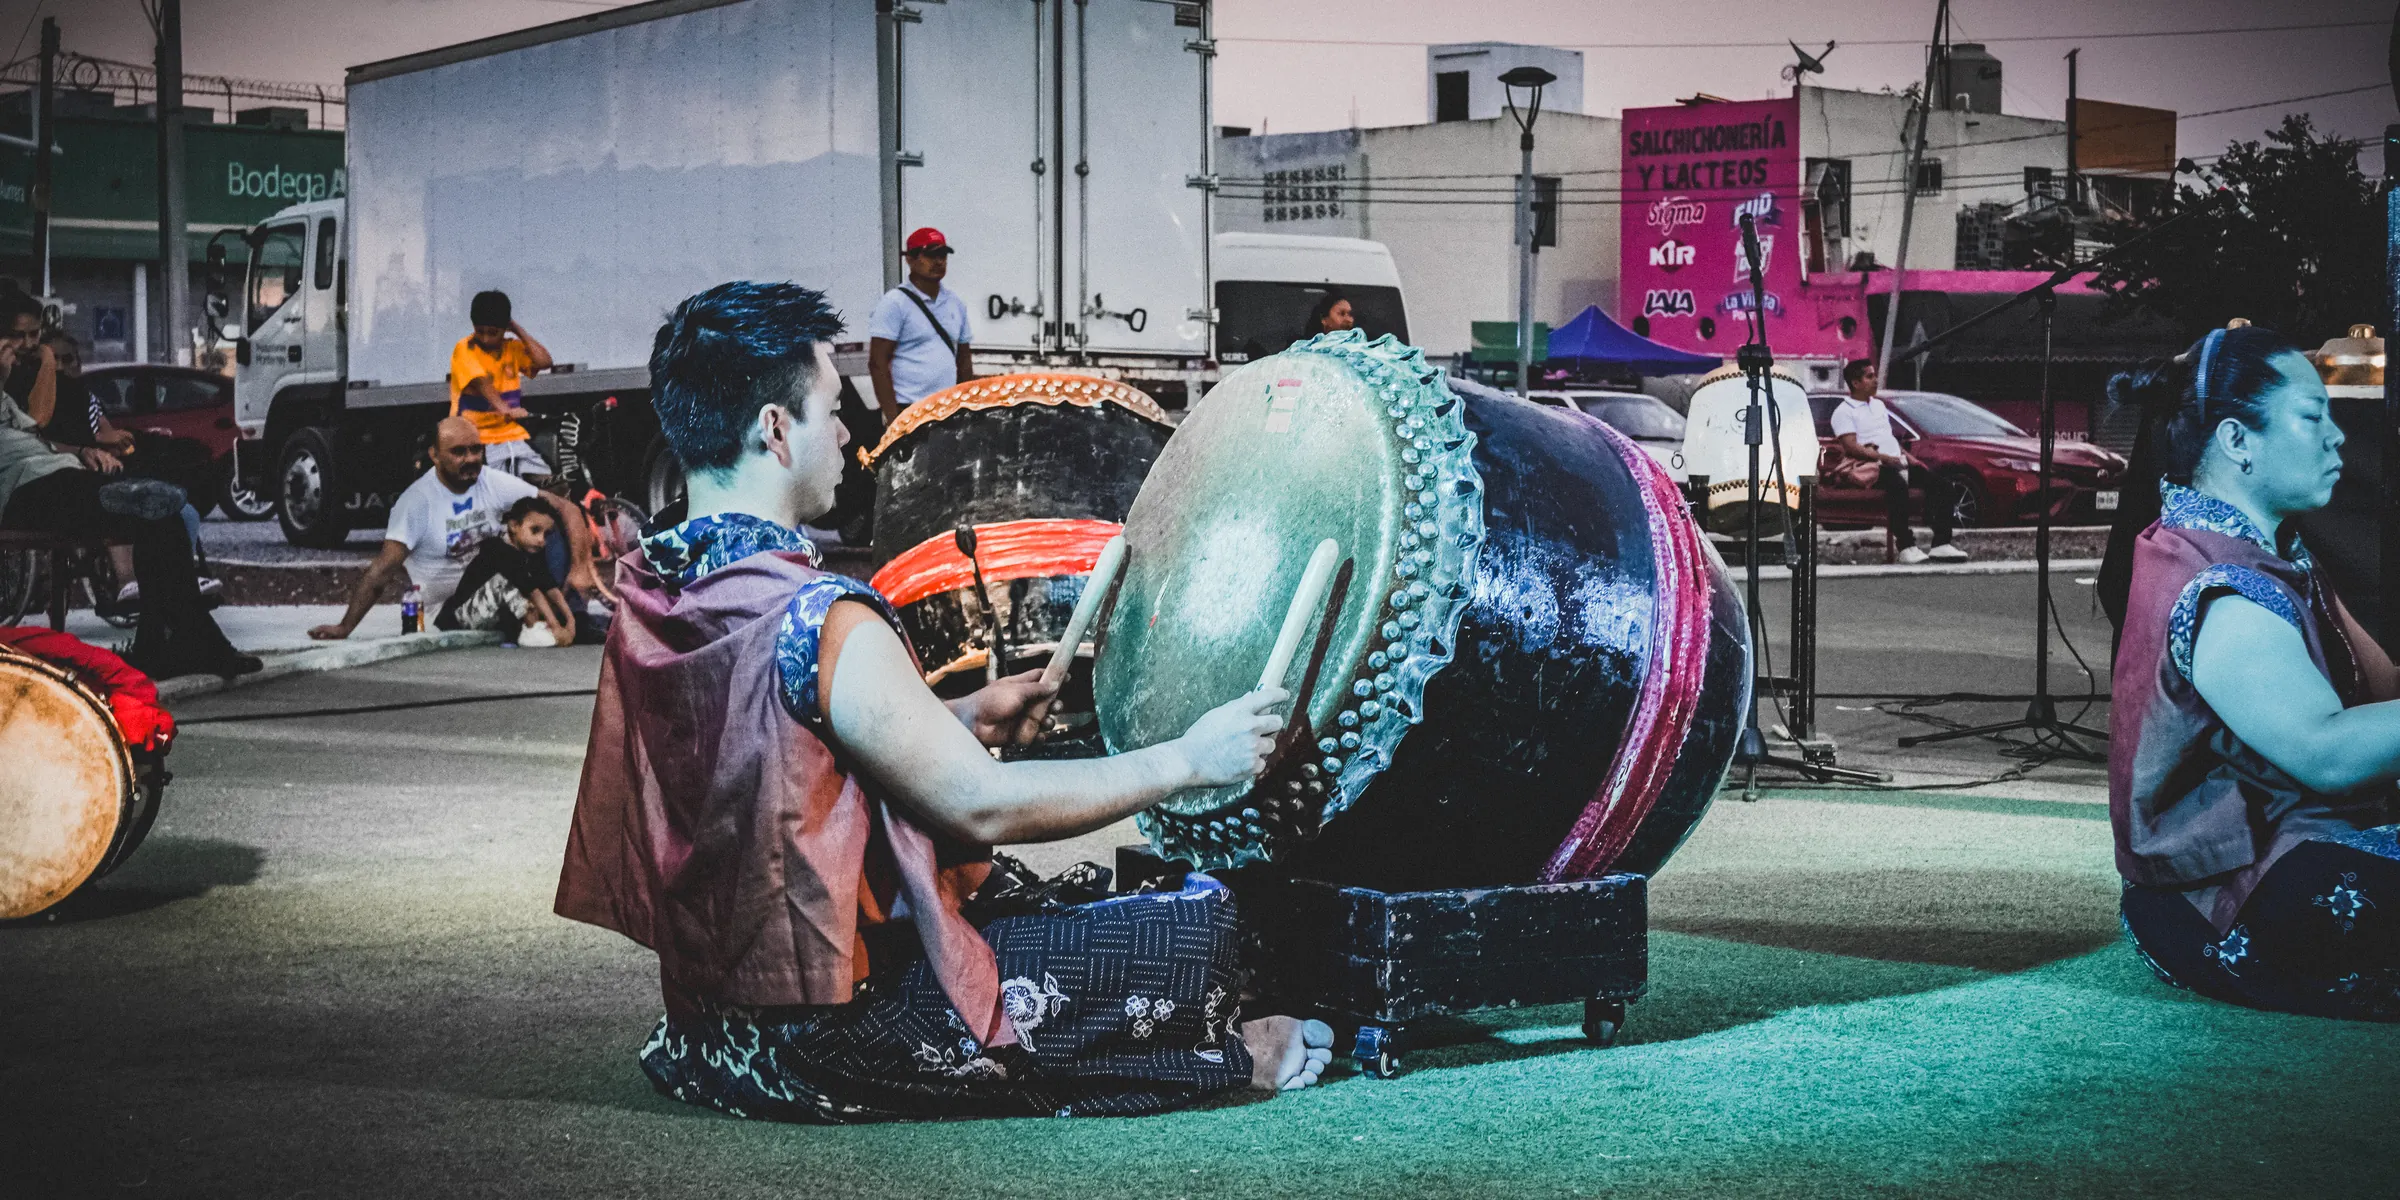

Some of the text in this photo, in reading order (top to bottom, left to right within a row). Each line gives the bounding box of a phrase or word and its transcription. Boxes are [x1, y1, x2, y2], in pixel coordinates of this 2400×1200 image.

[1629, 114, 1787, 156] SALCHICHONERÍA
[228, 162, 326, 204] Bodega
[1638, 158, 1768, 191] Y LACTEOS
[1647, 198, 1706, 236] Sigma
[1649, 240, 1696, 266] KIR
[1643, 289, 1697, 317] LALA
[1725, 296, 1739, 310] La
